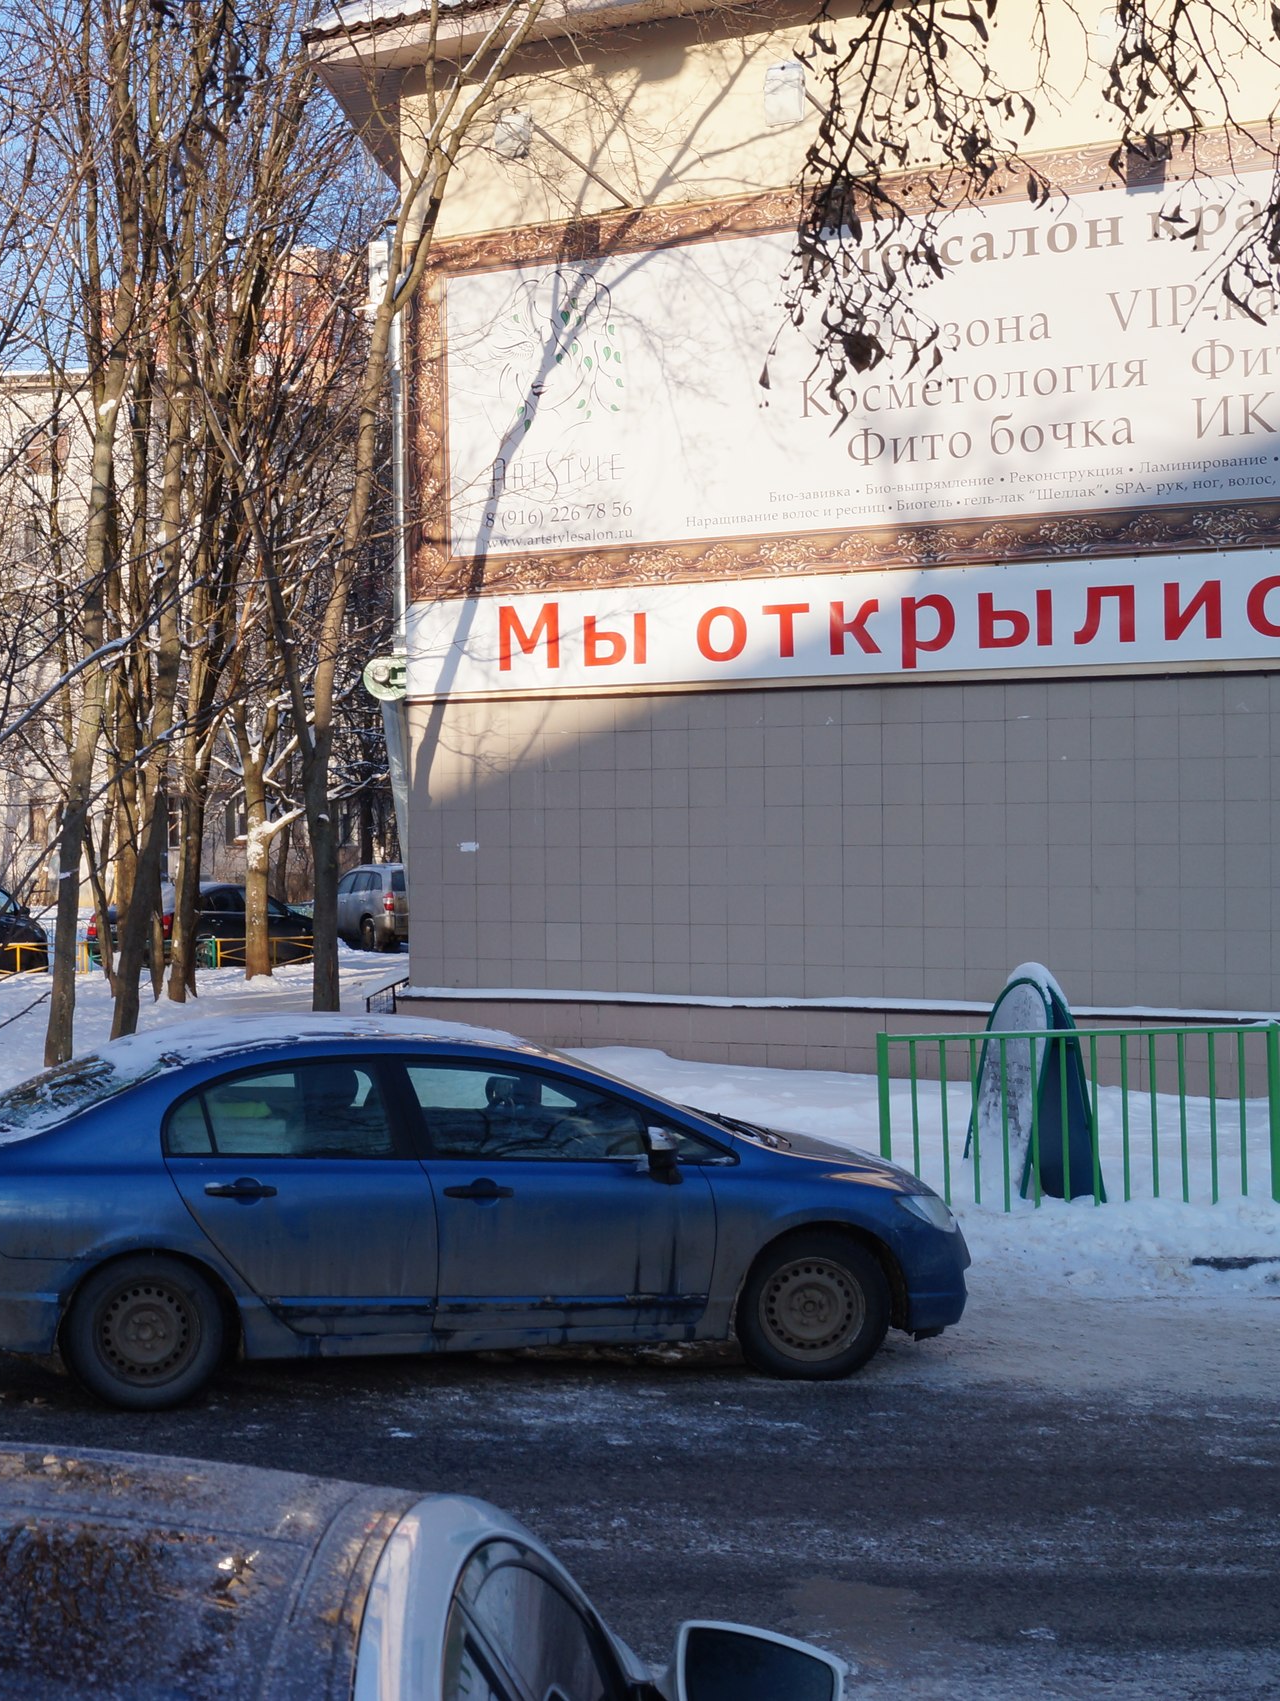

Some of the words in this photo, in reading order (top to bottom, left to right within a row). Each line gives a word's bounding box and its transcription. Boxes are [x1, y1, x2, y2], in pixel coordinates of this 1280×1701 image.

[1146, 199, 1280, 253] кра
[798, 358, 1149, 419] Косметология
[1191, 338, 1280, 381] Фи
[847, 427, 972, 467] Фито
[989, 412, 1136, 455] бочка
[1191, 391, 1278, 440] ИК
[686, 511, 779, 529] Наращивание
[782, 507, 820, 520] волос
[823, 507, 832, 517] и
[836, 503, 887, 518] ресниц
[897, 498, 953, 512] Биогель
[964, 492, 1025, 507] гель-лак
[1156, 480, 1188, 496] рук,
[1193, 477, 1224, 490] ног,
[1228, 474, 1277, 488] волос,
[769, 488, 851, 503] Био-завивка
[866, 476, 995, 495] Био-выпрямление
[1009, 466, 1124, 485] Реконструкция
[1138, 455, 1268, 474] Ламинирование
[484, 529, 634, 550] www.artstylesalon.ru
[485, 512, 496, 529] 8
[501, 508, 545, 531] (916)
[550, 505, 581, 523] 226
[586, 502, 606, 520] 78
[611, 500, 634, 518] 56
[499, 602, 648, 671] Мы
[696, 575, 1280, 669] открылис
